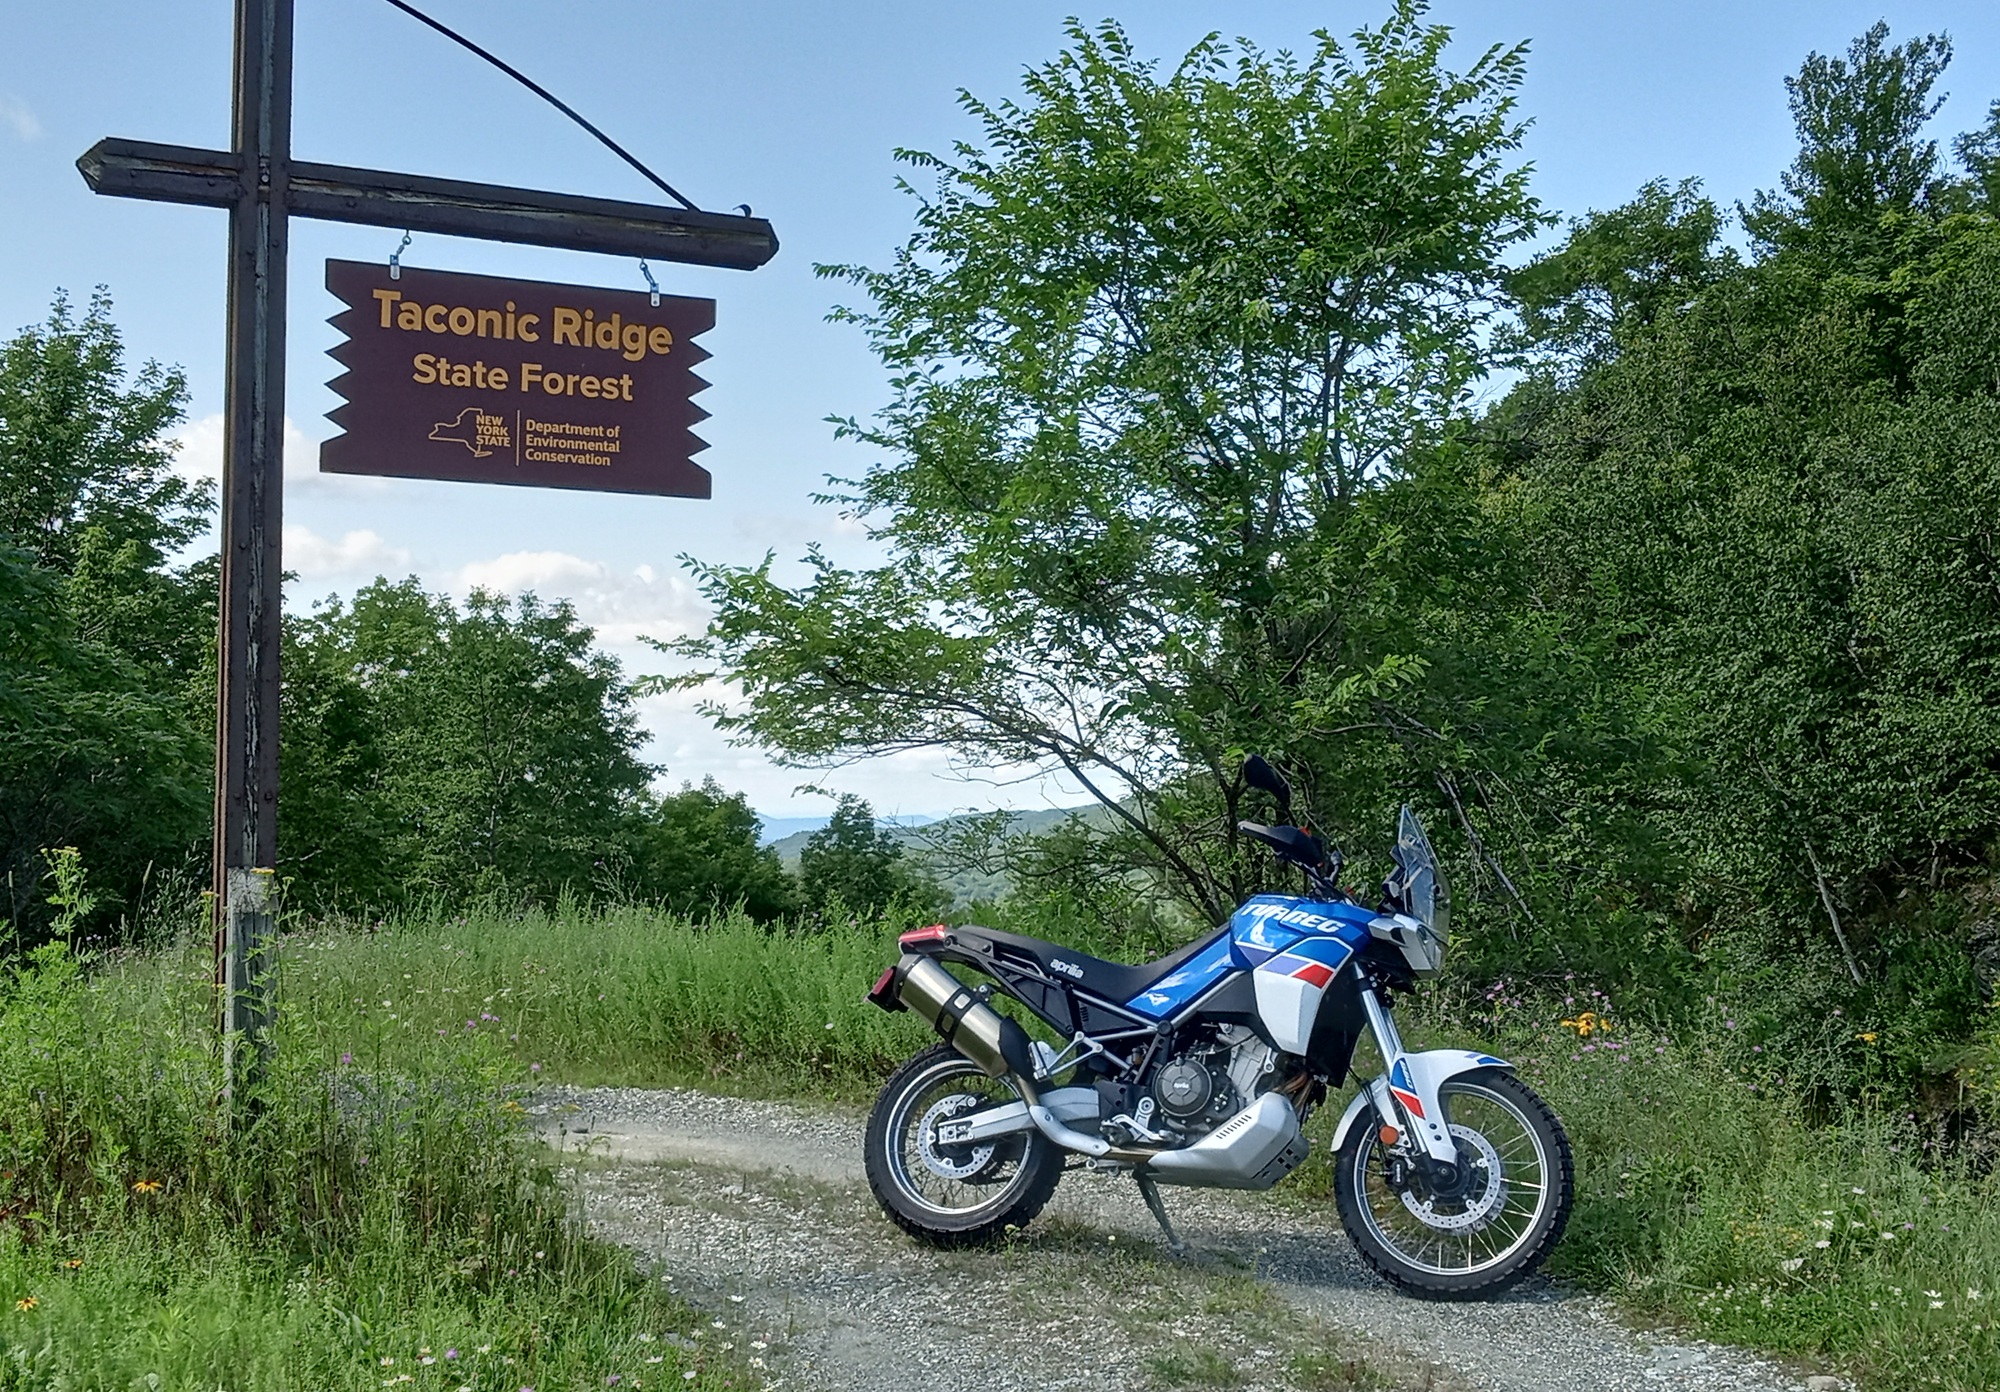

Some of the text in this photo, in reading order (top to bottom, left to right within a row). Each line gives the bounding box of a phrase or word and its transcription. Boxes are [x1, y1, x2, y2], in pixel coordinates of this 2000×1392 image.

[373, 288, 673, 361] Taconic Ridge
[412, 353, 634, 401] State Forest
[476, 414, 503, 426] NEW
[526, 419, 620, 438] Department of
[476, 425, 509, 437] YORK
[476, 435, 511, 447] STATE
[525, 434, 620, 452] Environmental
[525, 448, 611, 466] Conservation
[1050, 958, 1084, 979] aprilia
